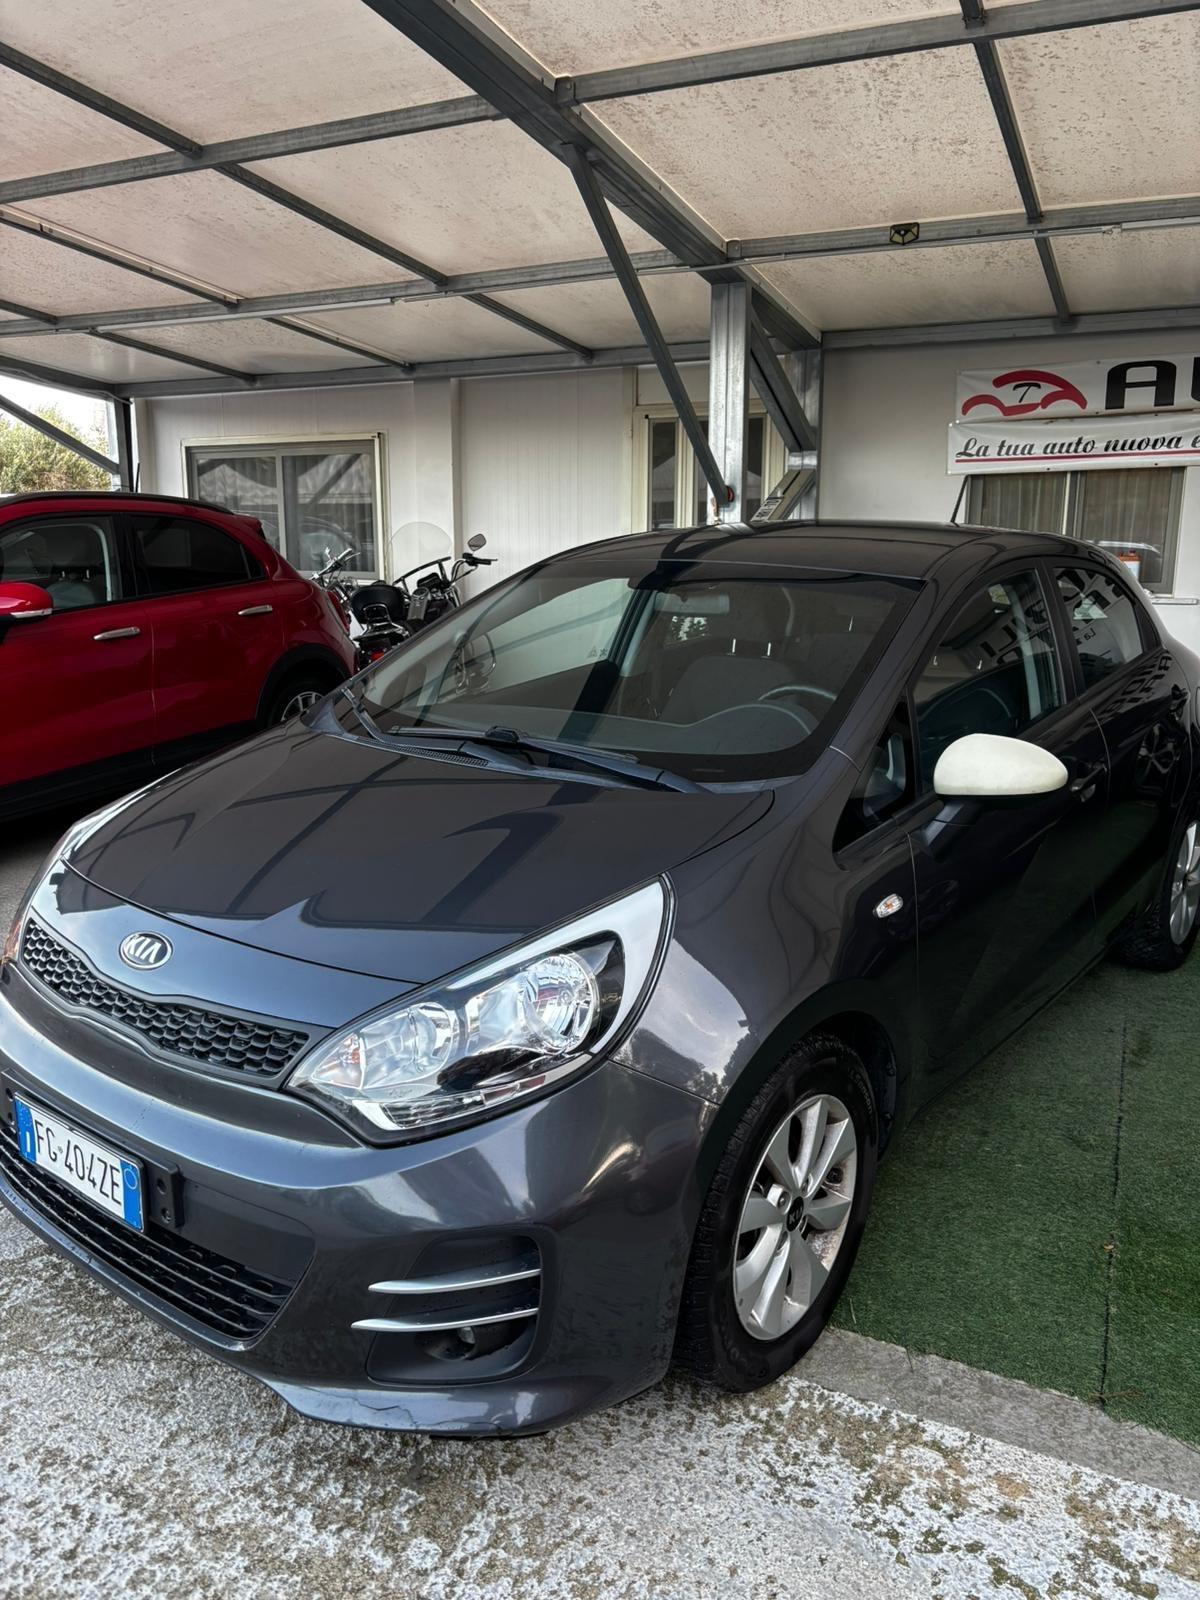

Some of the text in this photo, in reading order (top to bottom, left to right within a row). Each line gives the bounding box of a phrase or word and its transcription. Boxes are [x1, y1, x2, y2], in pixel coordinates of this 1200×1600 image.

[1105, 357, 1200, 410] A
[955, 437, 990, 458] La
[996, 439, 1036, 457] tua
[1042, 435, 1097, 455] auto
[1104, 435, 1184, 452] nuova
[123, 934, 162, 964] KIA
